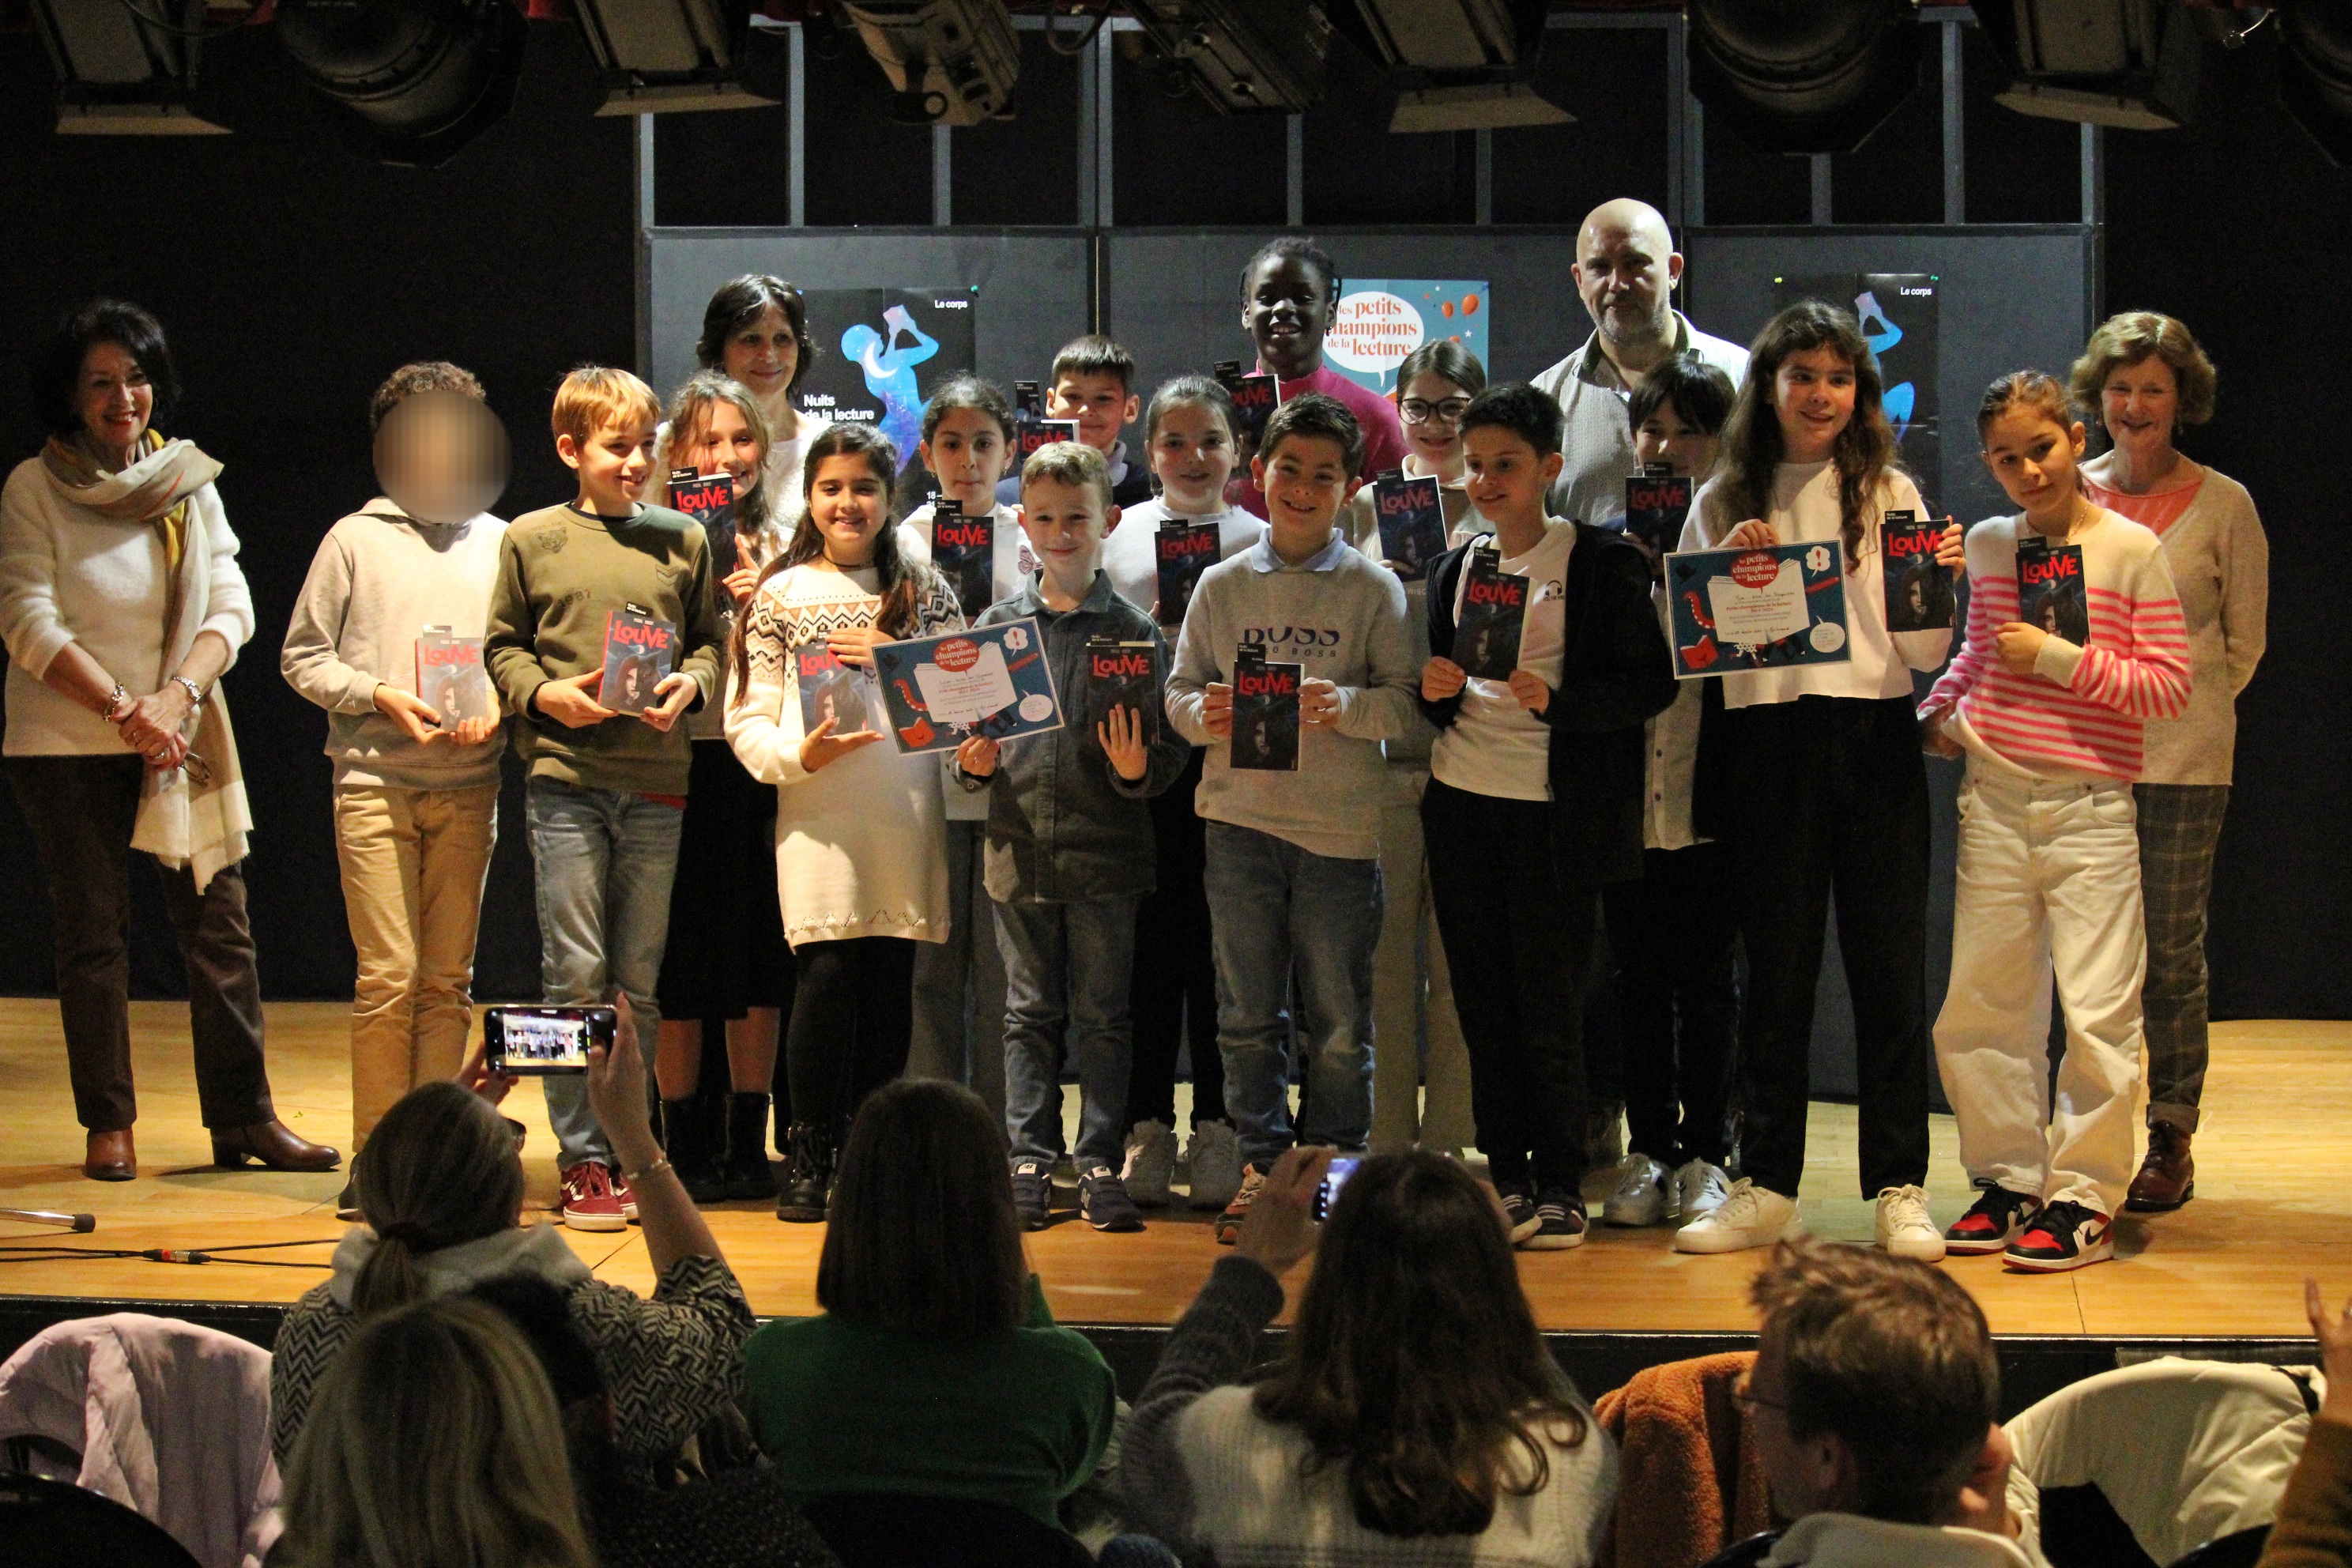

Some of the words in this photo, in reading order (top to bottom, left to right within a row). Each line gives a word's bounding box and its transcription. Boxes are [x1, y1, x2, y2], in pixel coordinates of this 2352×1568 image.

[1900, 286, 1909, 296] Le
[1910, 288, 1932, 298] corps
[934, 300, 944, 309] Le
[945, 300, 968, 311] corps
[1355, 297, 1402, 319] petits
[1325, 317, 1417, 340] hampions
[1328, 338, 1339, 349] de
[1341, 338, 1350, 349] la
[1352, 337, 1412, 356] lecture
[803, 394, 835, 407] Nuits
[835, 408, 875, 420] lecture
